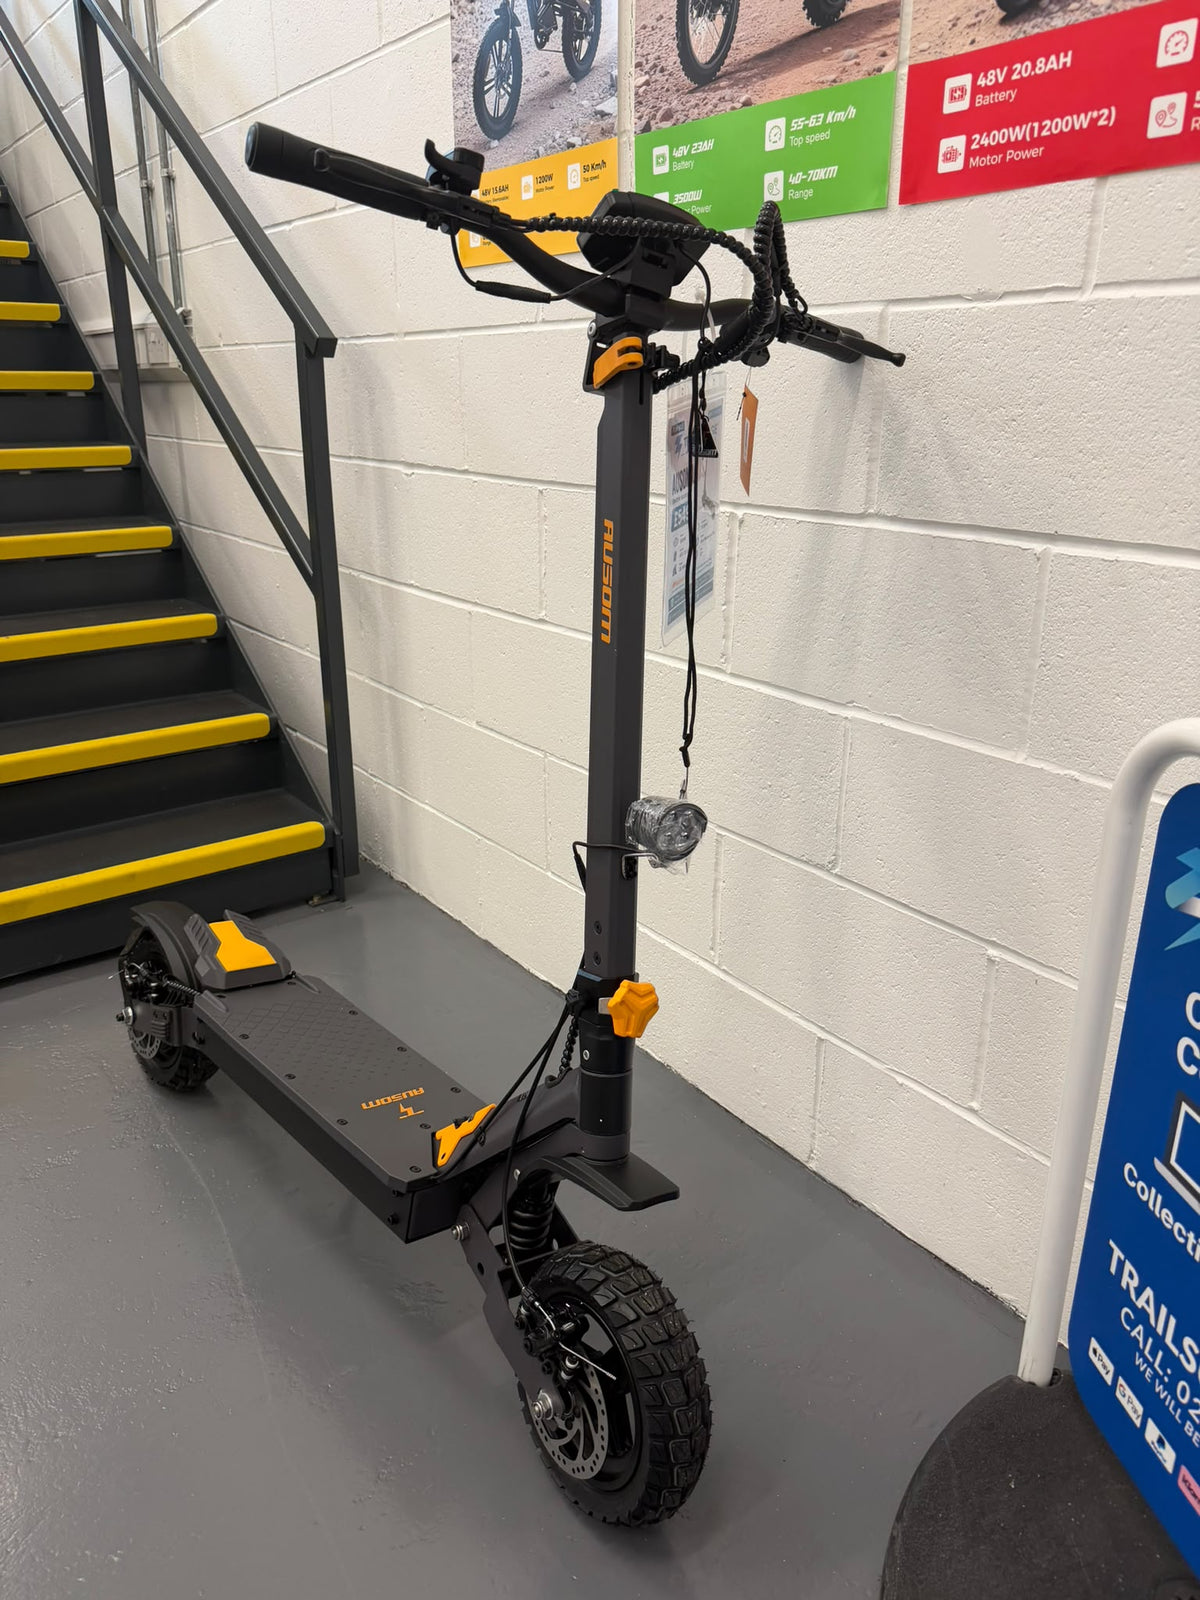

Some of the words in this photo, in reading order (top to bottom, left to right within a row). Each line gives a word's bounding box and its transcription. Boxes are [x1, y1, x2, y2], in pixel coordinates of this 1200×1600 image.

[976, 67, 1008, 88] 48V
[1011, 50, 1073, 81] 20.8AH
[975, 88, 1018, 107] Battery
[790, 113, 824, 132] 55-63
[826, 105, 857, 124] Km/h
[789, 135, 804, 148] Top
[805, 129, 831, 145] speed
[672, 145, 690, 158] 48V
[969, 154, 1003, 168] Motor
[1005, 145, 1045, 163] Power
[582, 165, 590, 174] 50
[591, 160, 607, 172] Km/h
[672, 159, 695, 172] Battery
[535, 173, 554, 185] 1200W
[673, 189, 702, 205] 3500W
[788, 187, 814, 200] Range
[691, 205, 712, 214] Power
[1108, 1239, 1200, 1384] TRAILS
[1120, 1306, 1172, 1383] CALL:
[1135, 1351, 1154, 1383] WE
[1155, 1378, 1182, 1424] WILL
